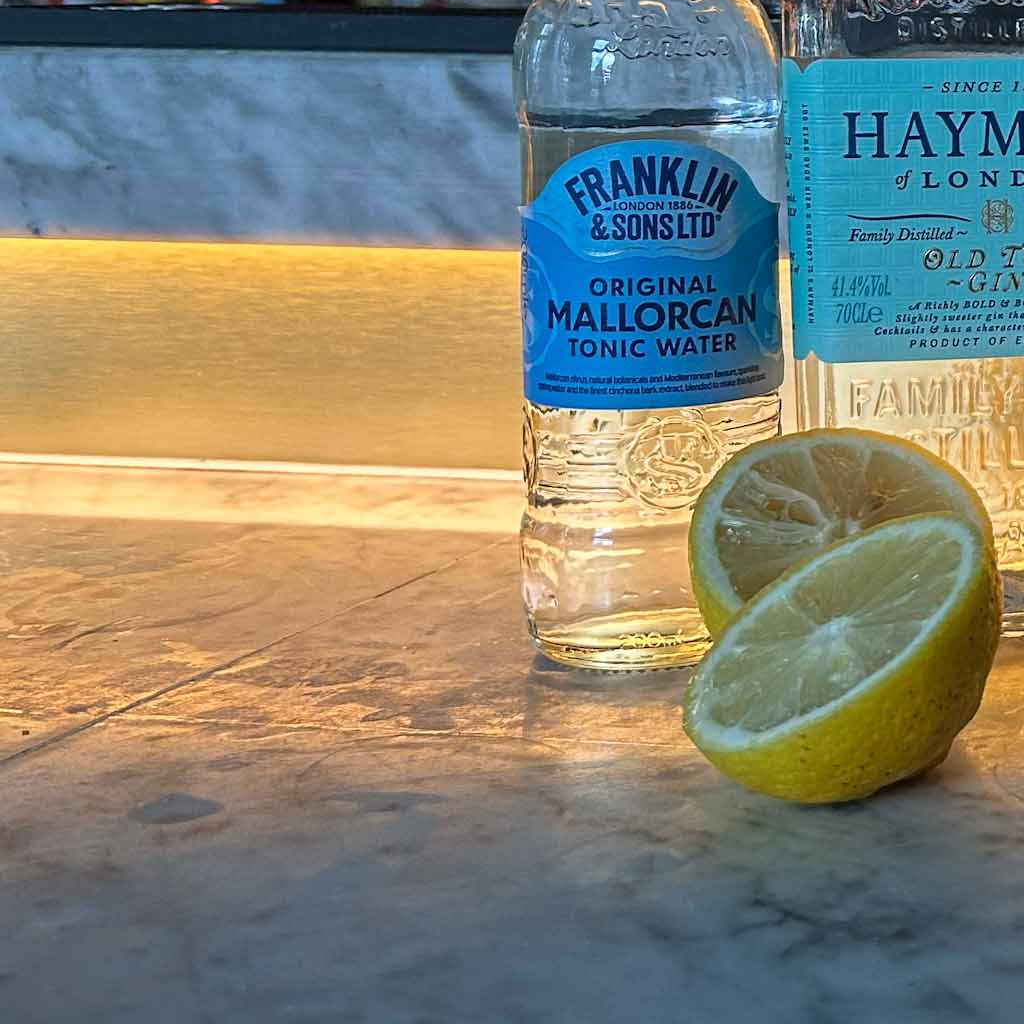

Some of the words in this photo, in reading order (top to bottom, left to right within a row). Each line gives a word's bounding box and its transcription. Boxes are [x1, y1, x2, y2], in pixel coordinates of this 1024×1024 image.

[941, 81, 1002, 93] SINCE
[563, 155, 739, 217] FRANKLIN
[895, 170, 913, 190] of
[613, 201, 665, 212] LONDON
[668, 201, 695, 211] 1886
[590, 213, 610, 241] &
[612, 213, 673, 241] SONS
[677, 212, 716, 240] LTD
[848, 228, 895, 245] Family
[896, 226, 954, 242] Distilled
[923, 246, 987, 271] OLD
[589, 274, 717, 297] ORIGINAL
[547, 293, 757, 333] MALLORCAN
[908, 302, 921, 311] A
[924, 300, 960, 312] Richly
[963, 299, 997, 309] BOLD
[1000, 298, 1011, 308] &
[895, 313, 939, 325] Slightly
[942, 314, 984, 322] sweeter
[985, 313, 1004, 323] gin
[874, 325, 926, 336] Cocktails
[929, 325, 940, 334] &
[943, 324, 961, 333] has
[568, 338, 646, 359] TONIC
[656, 332, 738, 356] WATER
[909, 337, 980, 349] PRODUCT
[988, 336, 1008, 346] OF
